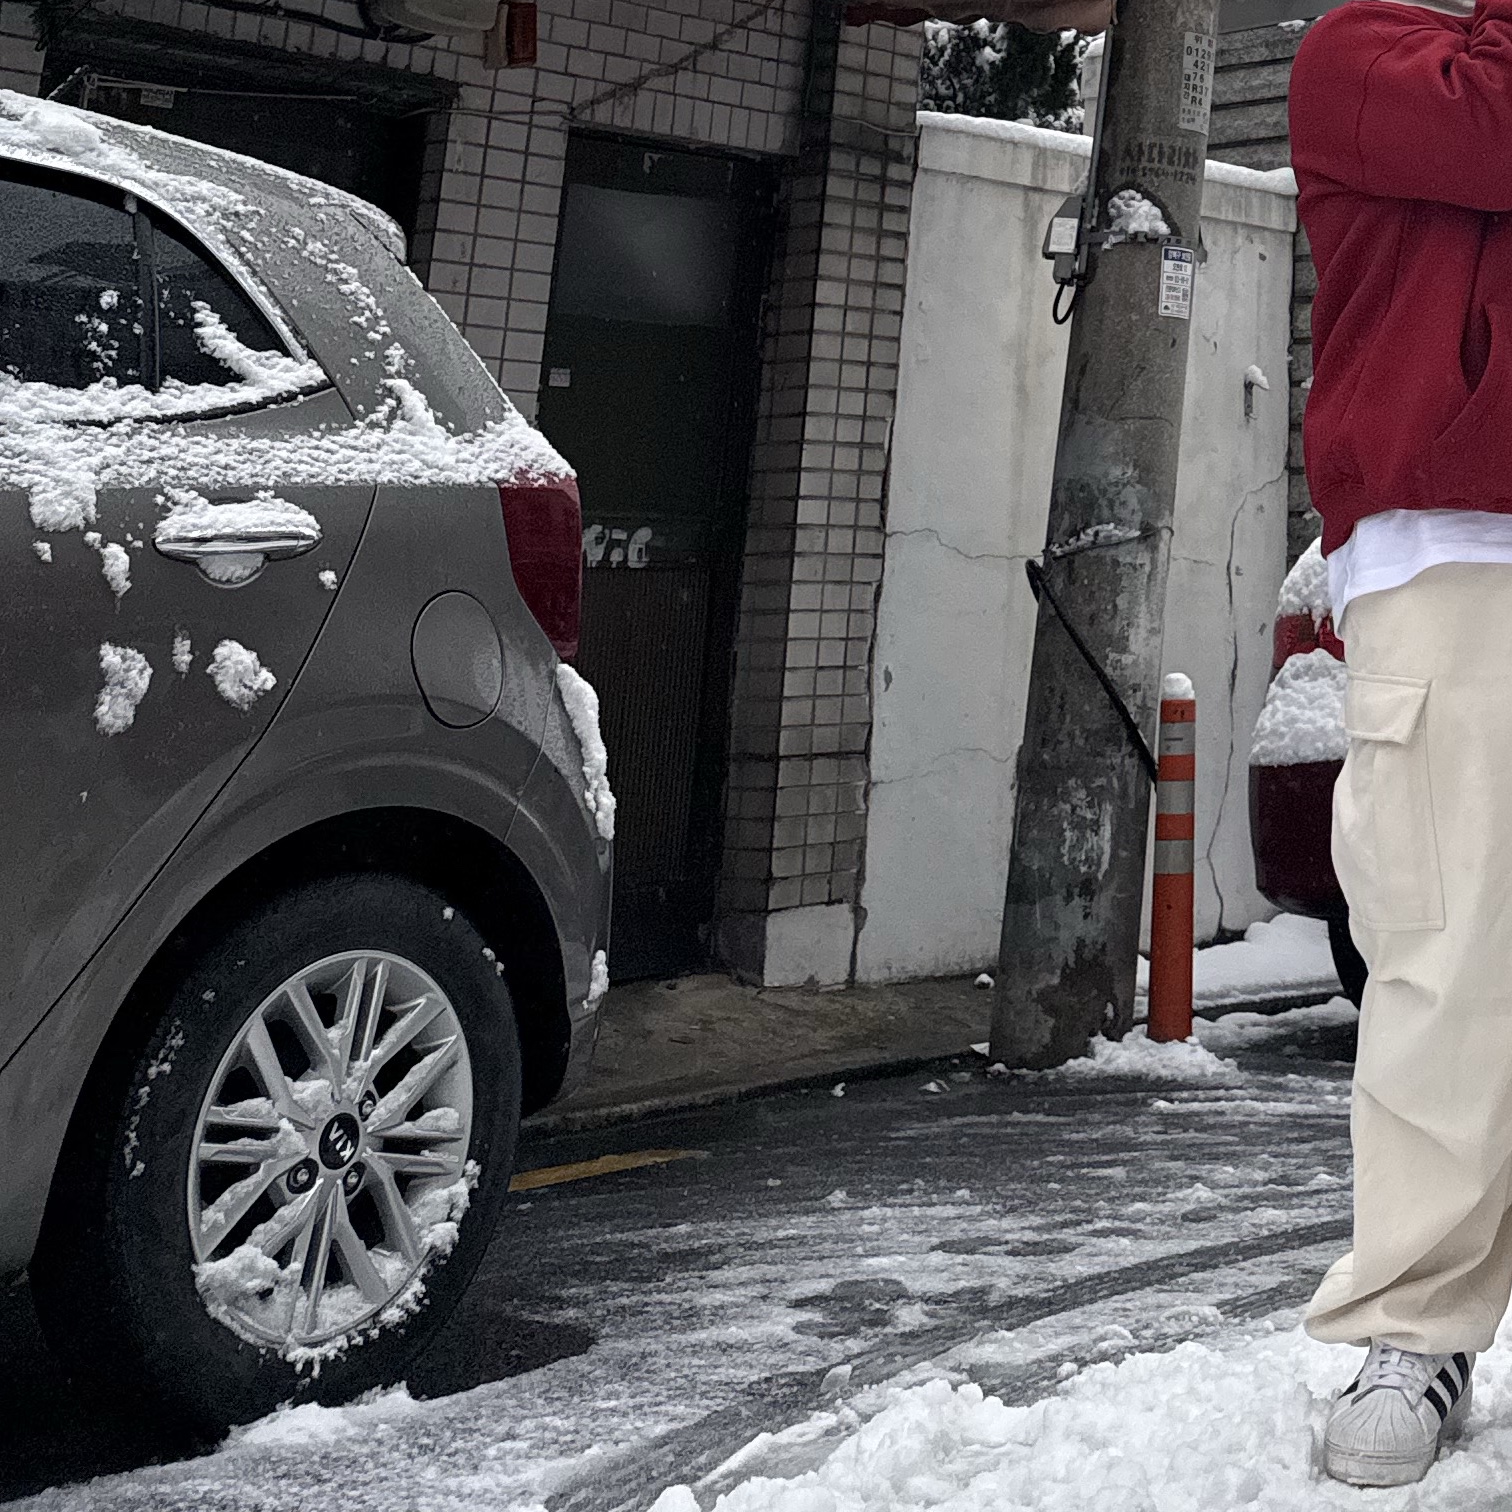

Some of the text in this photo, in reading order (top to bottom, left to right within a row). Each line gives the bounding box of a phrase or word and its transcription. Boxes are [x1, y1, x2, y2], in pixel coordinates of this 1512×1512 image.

[1186, 45, 1214, 60] 0129
[1193, 59, 1210, 73] 421
[1193, 71, 1205, 84] 76
[1190, 95, 1203, 107] R4
[329, 1121, 355, 1162] KIA
